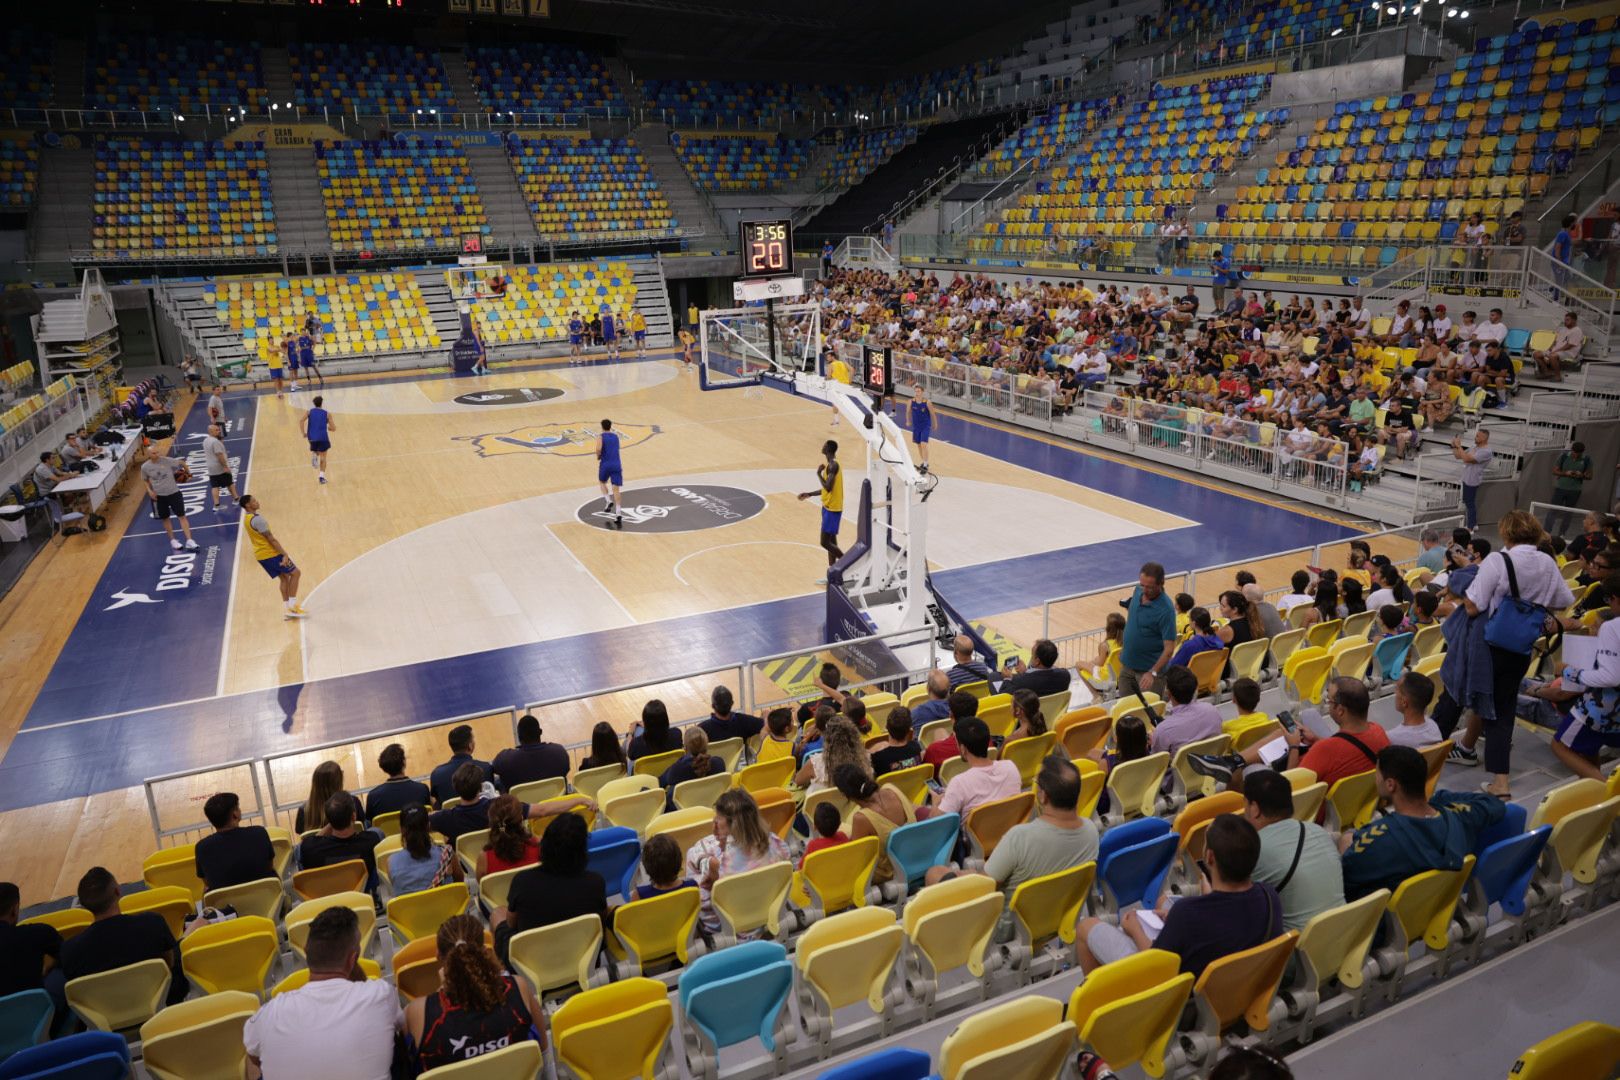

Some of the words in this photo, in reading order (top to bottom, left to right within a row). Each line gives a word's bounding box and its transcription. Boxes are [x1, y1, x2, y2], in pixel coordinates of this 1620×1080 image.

[274, 128, 293, 136] GRAN
[275, 137, 305, 145] CANARIA
[756, 225, 786, 241] 3:56
[464, 239, 480, 252] 20
[752, 242, 784, 270] 20
[871, 366, 883, 385] 20
